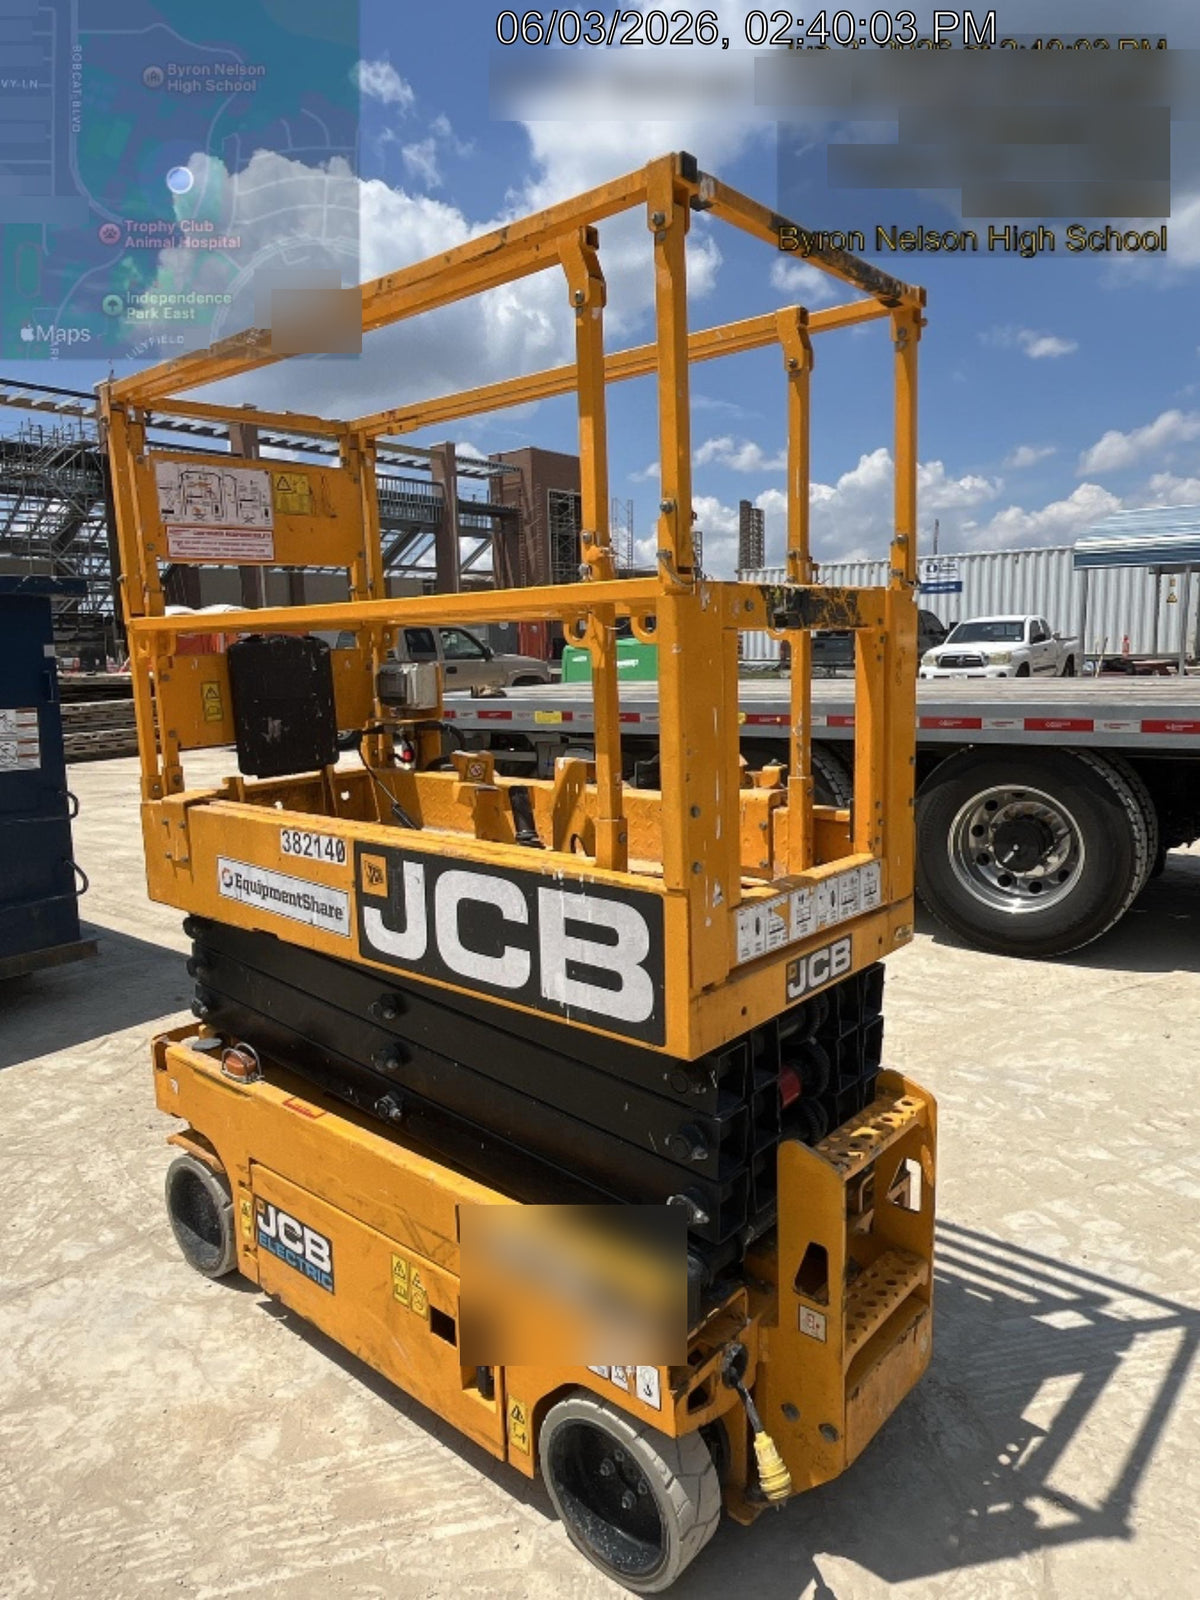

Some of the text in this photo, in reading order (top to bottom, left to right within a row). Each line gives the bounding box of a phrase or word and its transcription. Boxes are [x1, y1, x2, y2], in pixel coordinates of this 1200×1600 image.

[281, 831, 346, 863] 382140
[235, 872, 344, 920] EquipmentShare
[364, 860, 654, 1023] JCB
[788, 938, 850, 998] JCB
[257, 1204, 332, 1274] JCB
[259, 1231, 333, 1293] ELECTRIC
